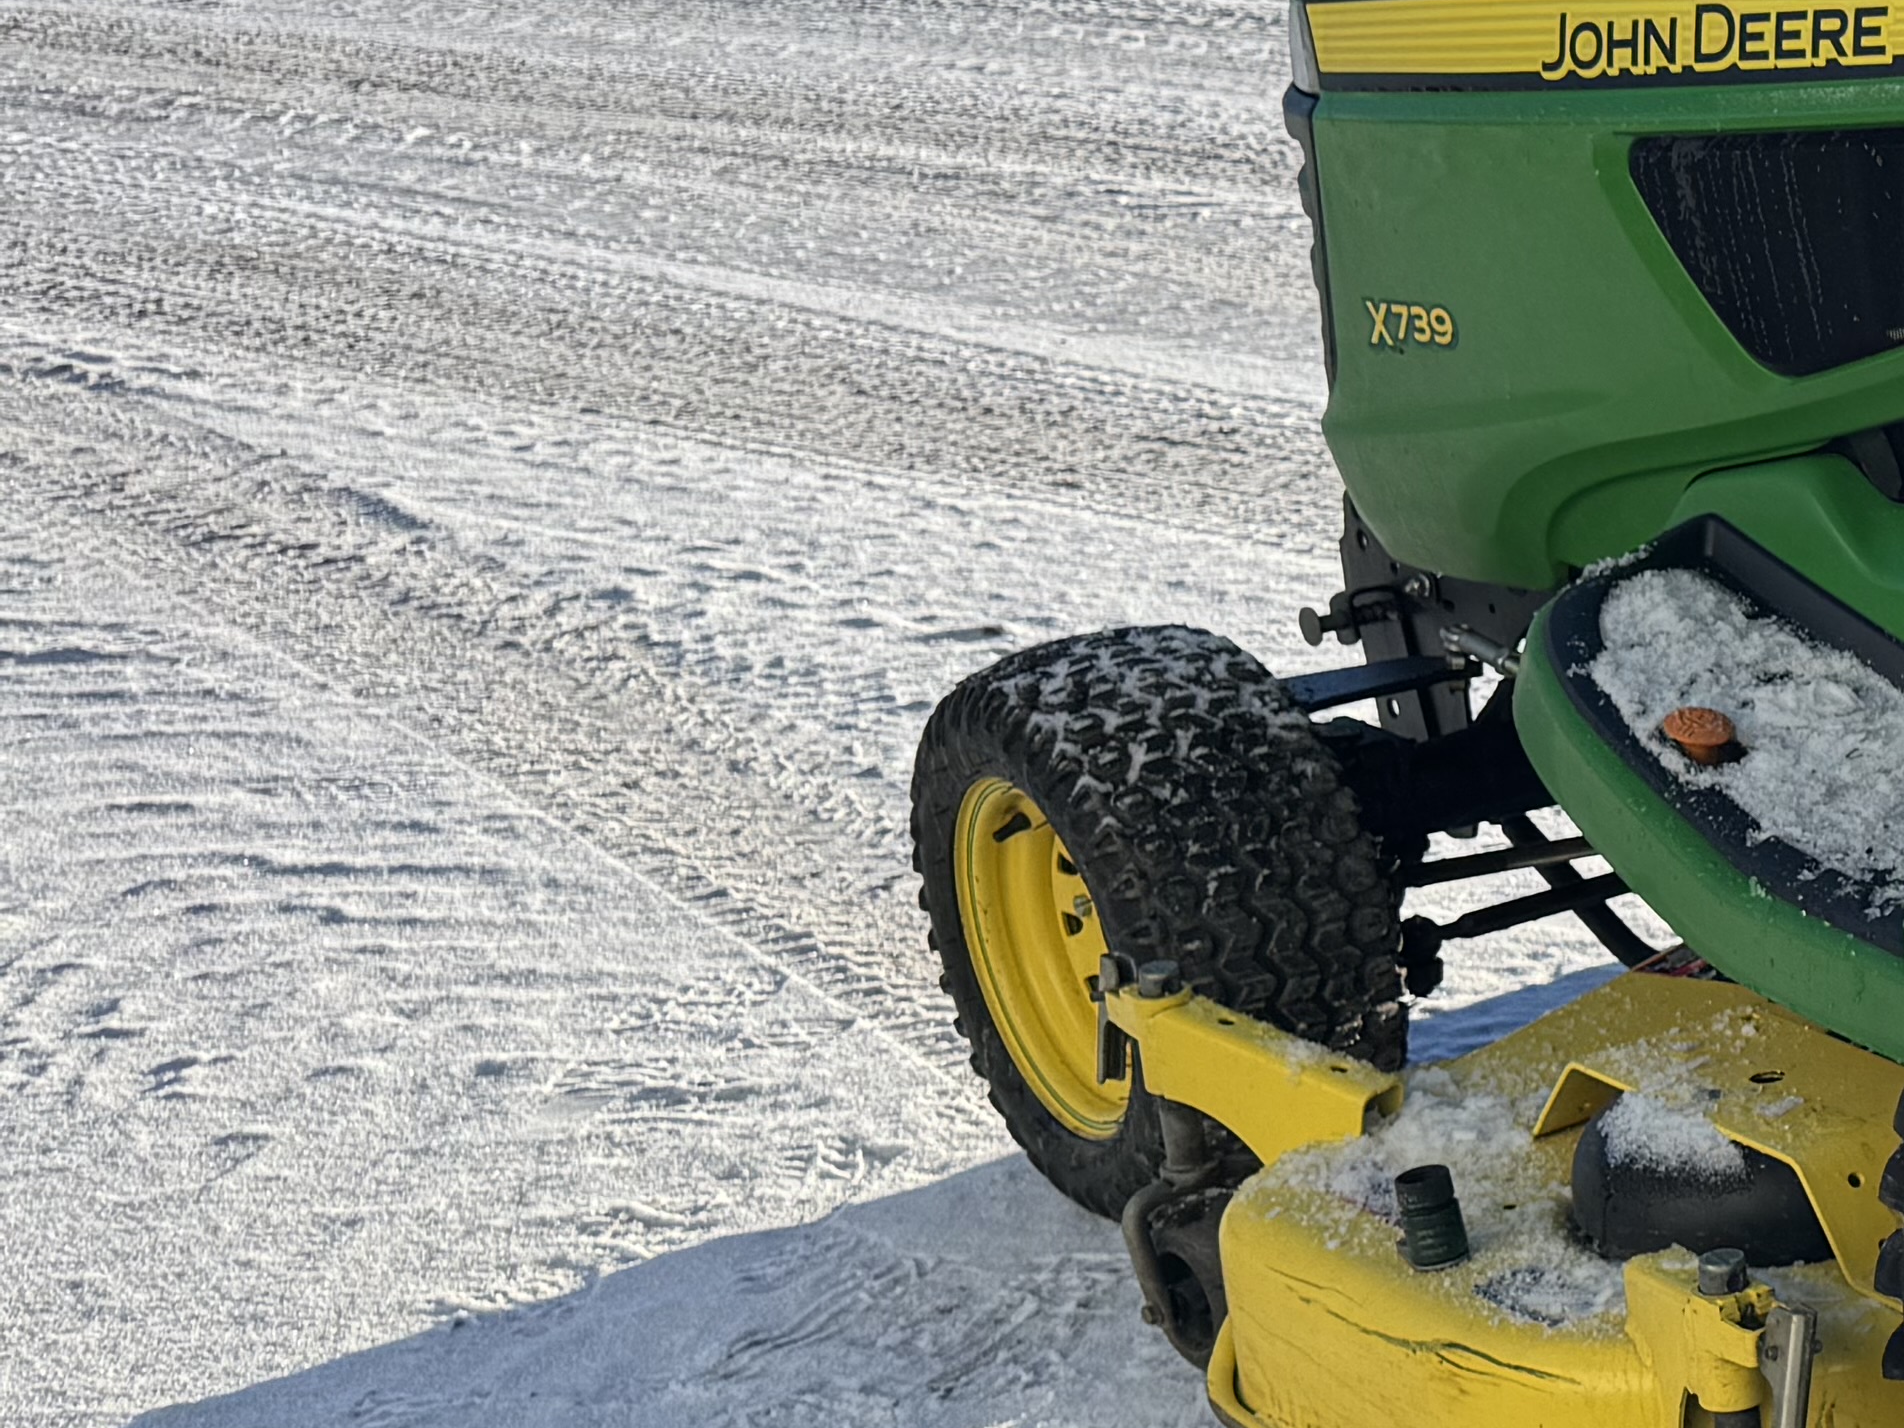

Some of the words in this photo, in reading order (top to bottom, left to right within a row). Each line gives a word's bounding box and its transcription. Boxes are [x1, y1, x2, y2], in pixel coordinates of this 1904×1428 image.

[1541, 12, 1678, 72] JOHN
[1694, 3, 1889, 64] DEERE
[1364, 299, 1453, 346] X739
